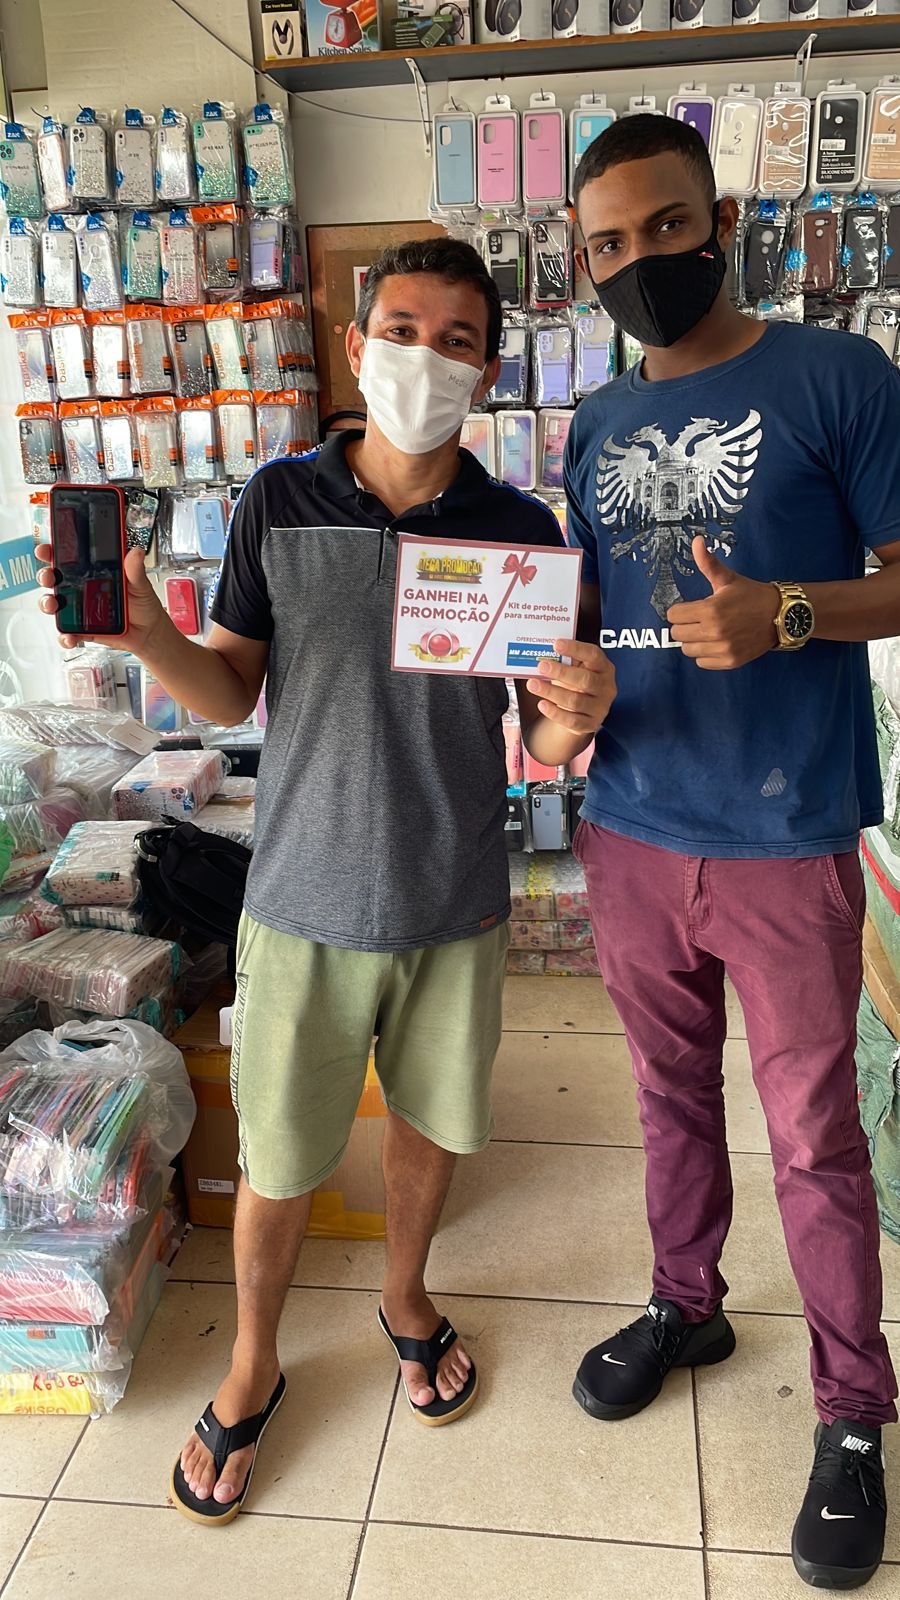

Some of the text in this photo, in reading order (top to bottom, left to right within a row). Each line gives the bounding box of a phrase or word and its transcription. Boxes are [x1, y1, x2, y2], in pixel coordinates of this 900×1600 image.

[318, 44, 371, 56] Kitchen Scales
[9, 553, 35, 586] MM
[417, 558, 482, 576] MEGA PROMOÇÃO
[403, 588, 489, 605] GANHEI NA
[400, 606, 490, 623] PROMOÇÃO
[533, 604, 569, 613] proteção
[524, 613, 571, 622] smartphone
[841, 1434, 873, 1455] NIKE
